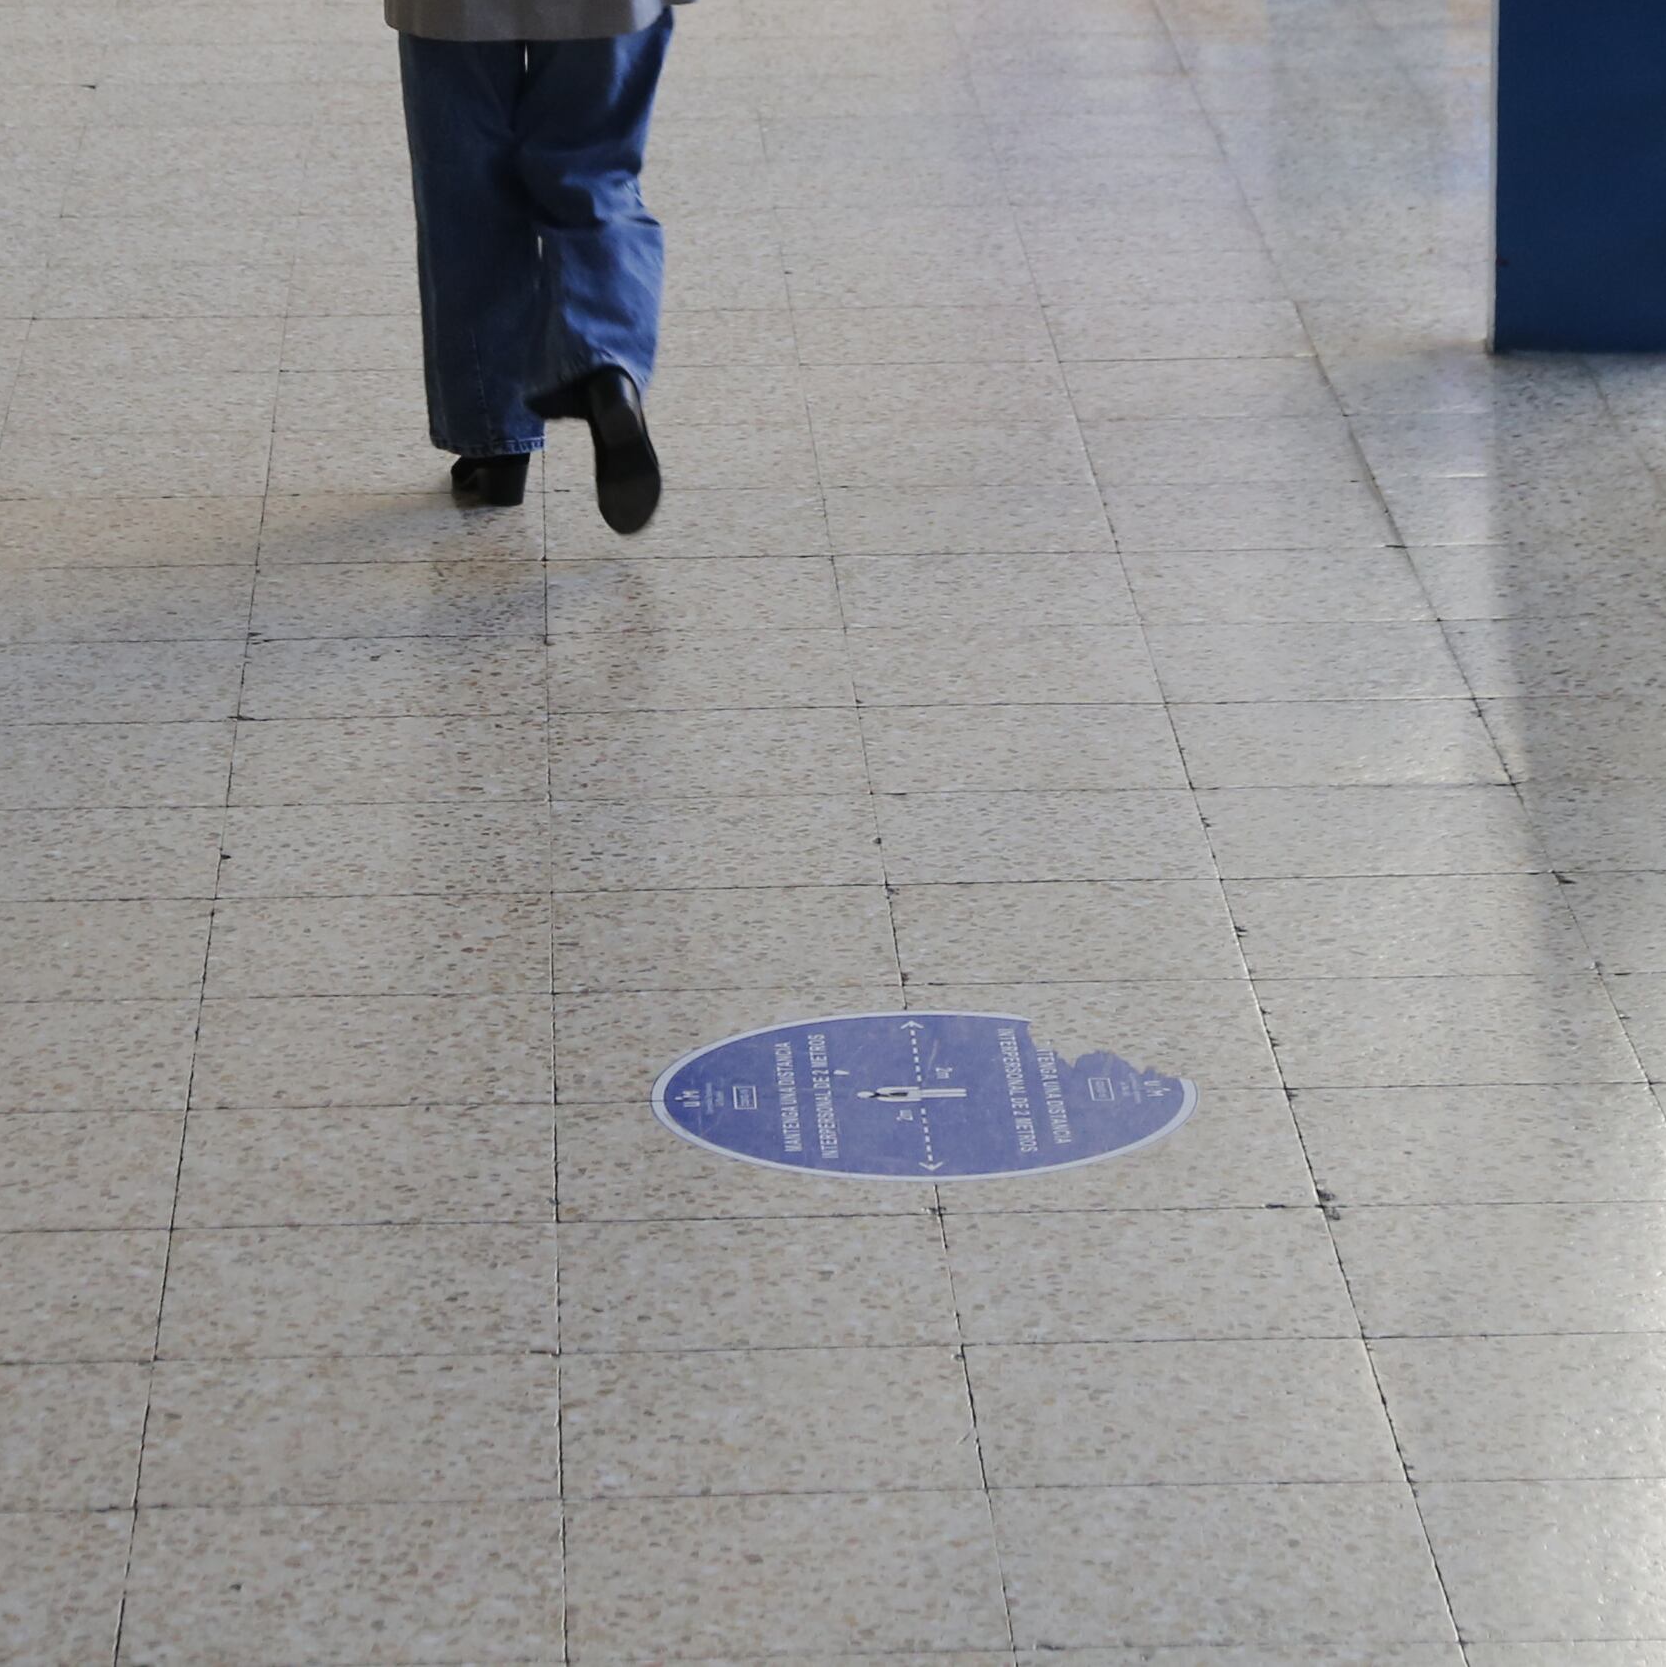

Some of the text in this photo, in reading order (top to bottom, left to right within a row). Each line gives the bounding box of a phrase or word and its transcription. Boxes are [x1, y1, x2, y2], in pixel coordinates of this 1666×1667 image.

[807, 1034, 829, 1068] METROS
[997, 1028, 1026, 1096] INTERPERSONAL
[812, 1077, 832, 1089] DE
[935, 1067, 953, 1079] 2m
[774, 1041, 803, 1152] MANTENGA UNA DISTANCIA
[1010, 1097, 1030, 1109] DE
[1042, 1081, 1063, 1100] UNA
[813, 1091, 840, 1159] INTERPERSONAL
[1015, 1118, 1038, 1153] METROS
[1046, 1100, 1073, 1145] DISTANCIA
